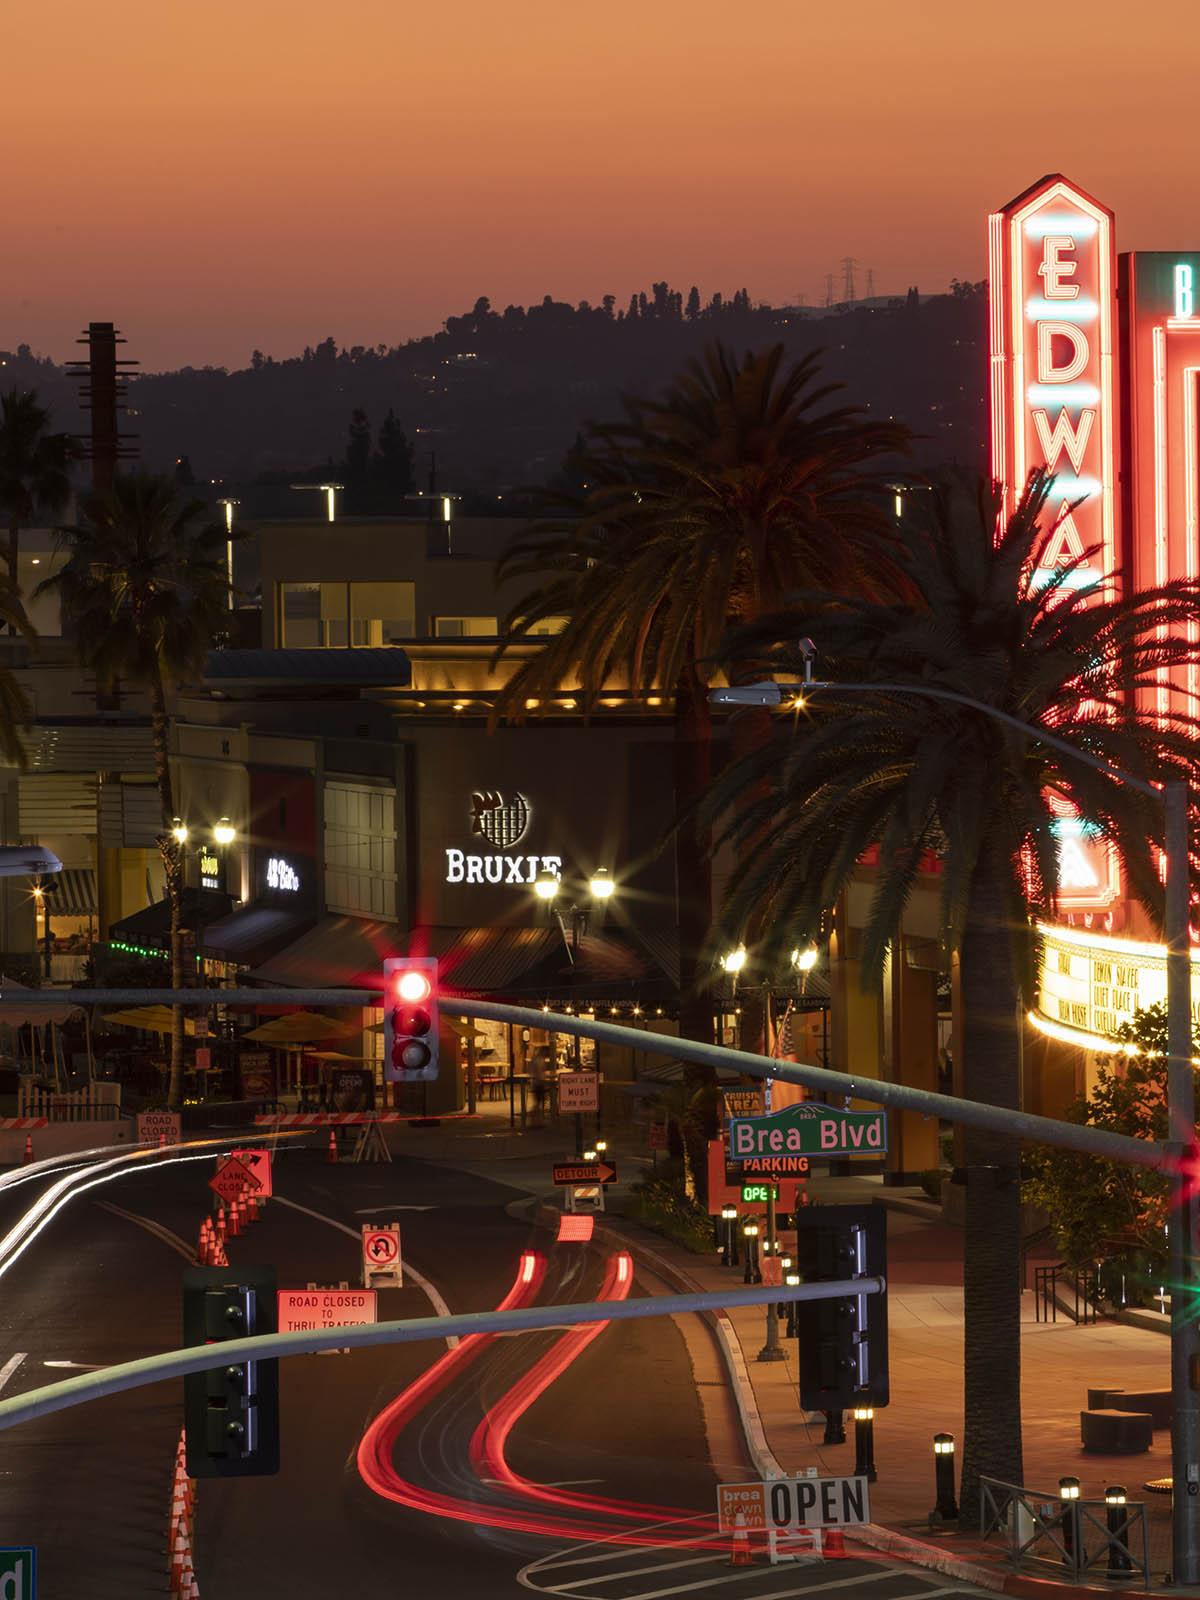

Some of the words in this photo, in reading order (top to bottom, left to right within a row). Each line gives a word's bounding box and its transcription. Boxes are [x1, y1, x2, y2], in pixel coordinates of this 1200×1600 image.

[445, 848, 563, 884] BRUXIE
[561, 1077, 579, 1085] RIGHT
[580, 1077, 596, 1085] LANE
[568, 1087, 589, 1097] MUST
[728, 1100, 762, 1111] REA
[145, 1116, 172, 1125] ROAD
[141, 1126, 178, 1136] CLOSED
[736, 1124, 801, 1153] Brea
[820, 1118, 881, 1149] Blvd
[743, 1157, 809, 1172] PARKING
[222, 1172, 246, 1180] LANE
[556, 1168, 600, 1180] DETOUR
[289, 1296, 318, 1308] ROAD
[323, 1296, 365, 1308] CLOSED
[321, 1309, 333, 1319] TO
[723, 1489, 761, 1502] brea
[770, 1479, 865, 1527] OPEN
[725, 1515, 763, 1527] twn
